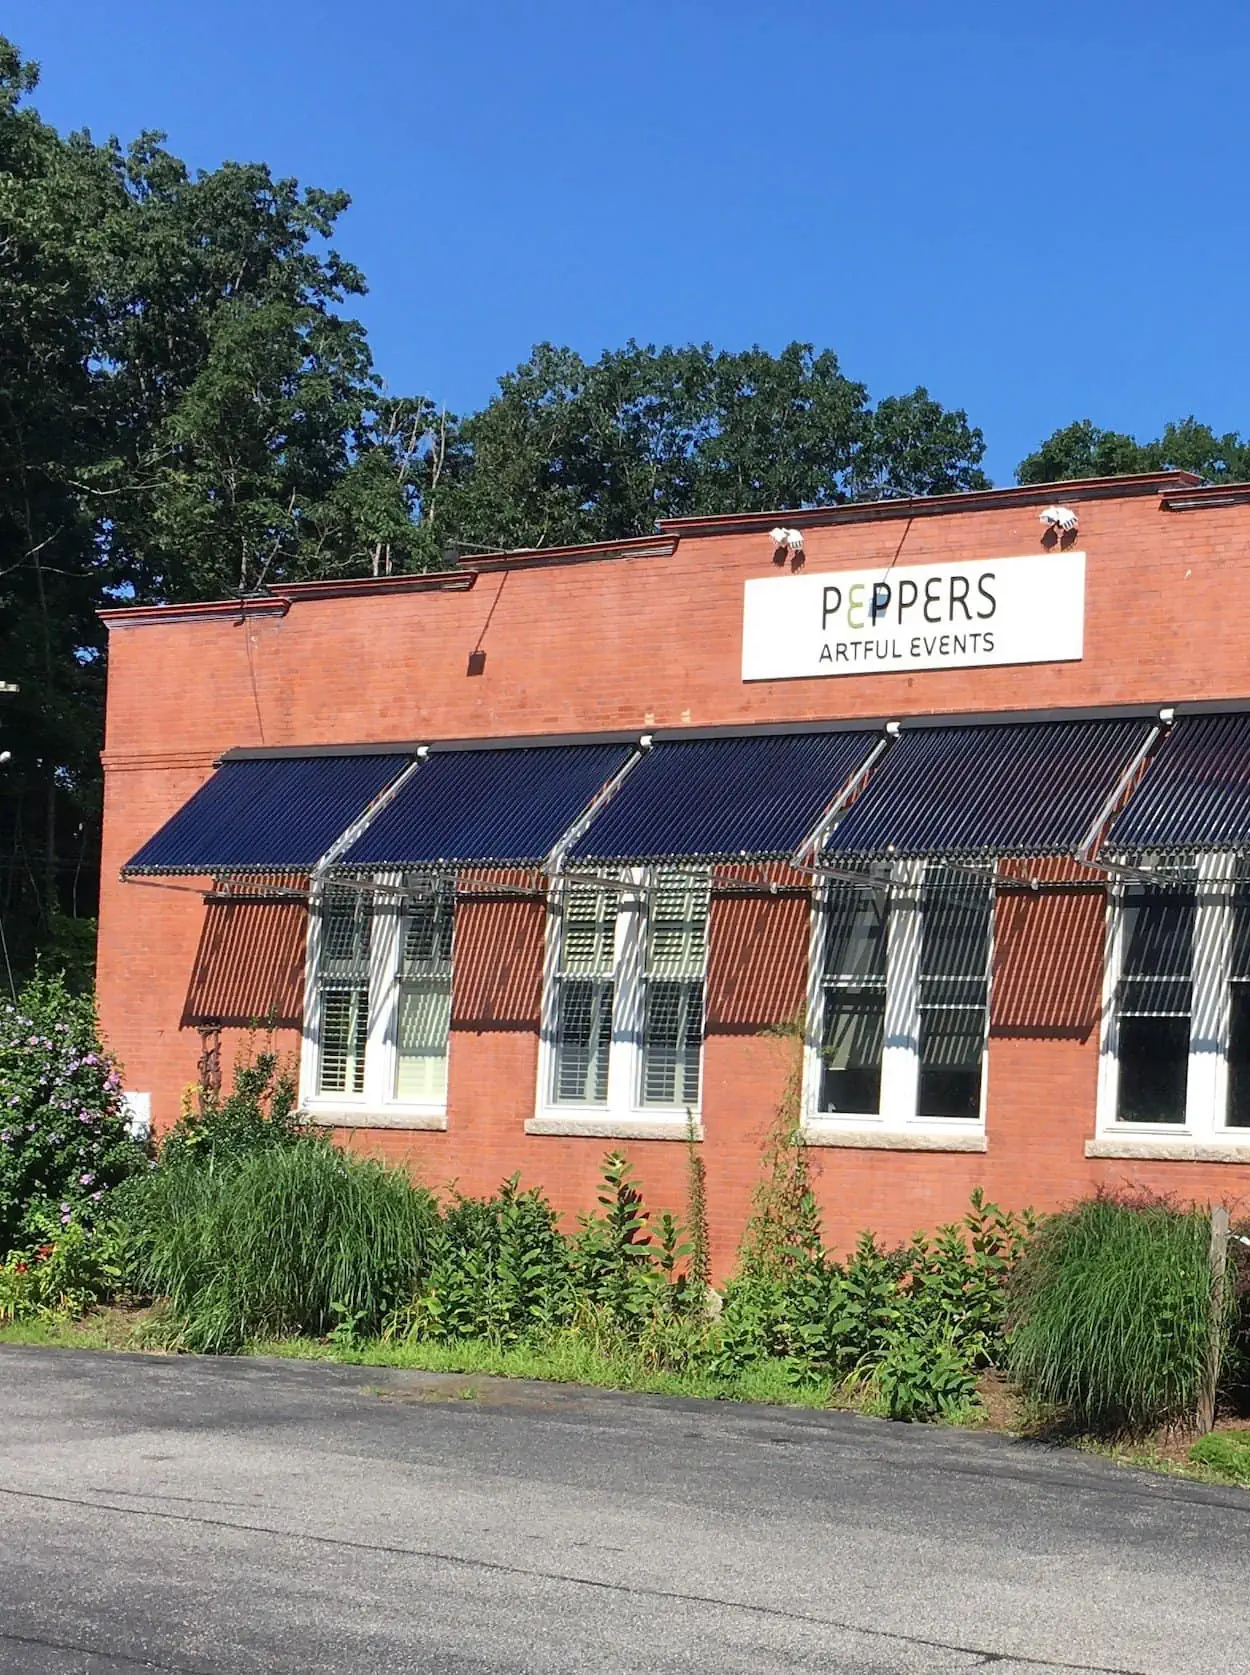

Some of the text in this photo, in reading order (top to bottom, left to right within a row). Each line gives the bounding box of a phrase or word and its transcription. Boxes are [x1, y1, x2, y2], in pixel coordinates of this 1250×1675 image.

[822, 572, 997, 631] PEPPERS
[819, 632, 995, 664] ARTFUL EVENTS
